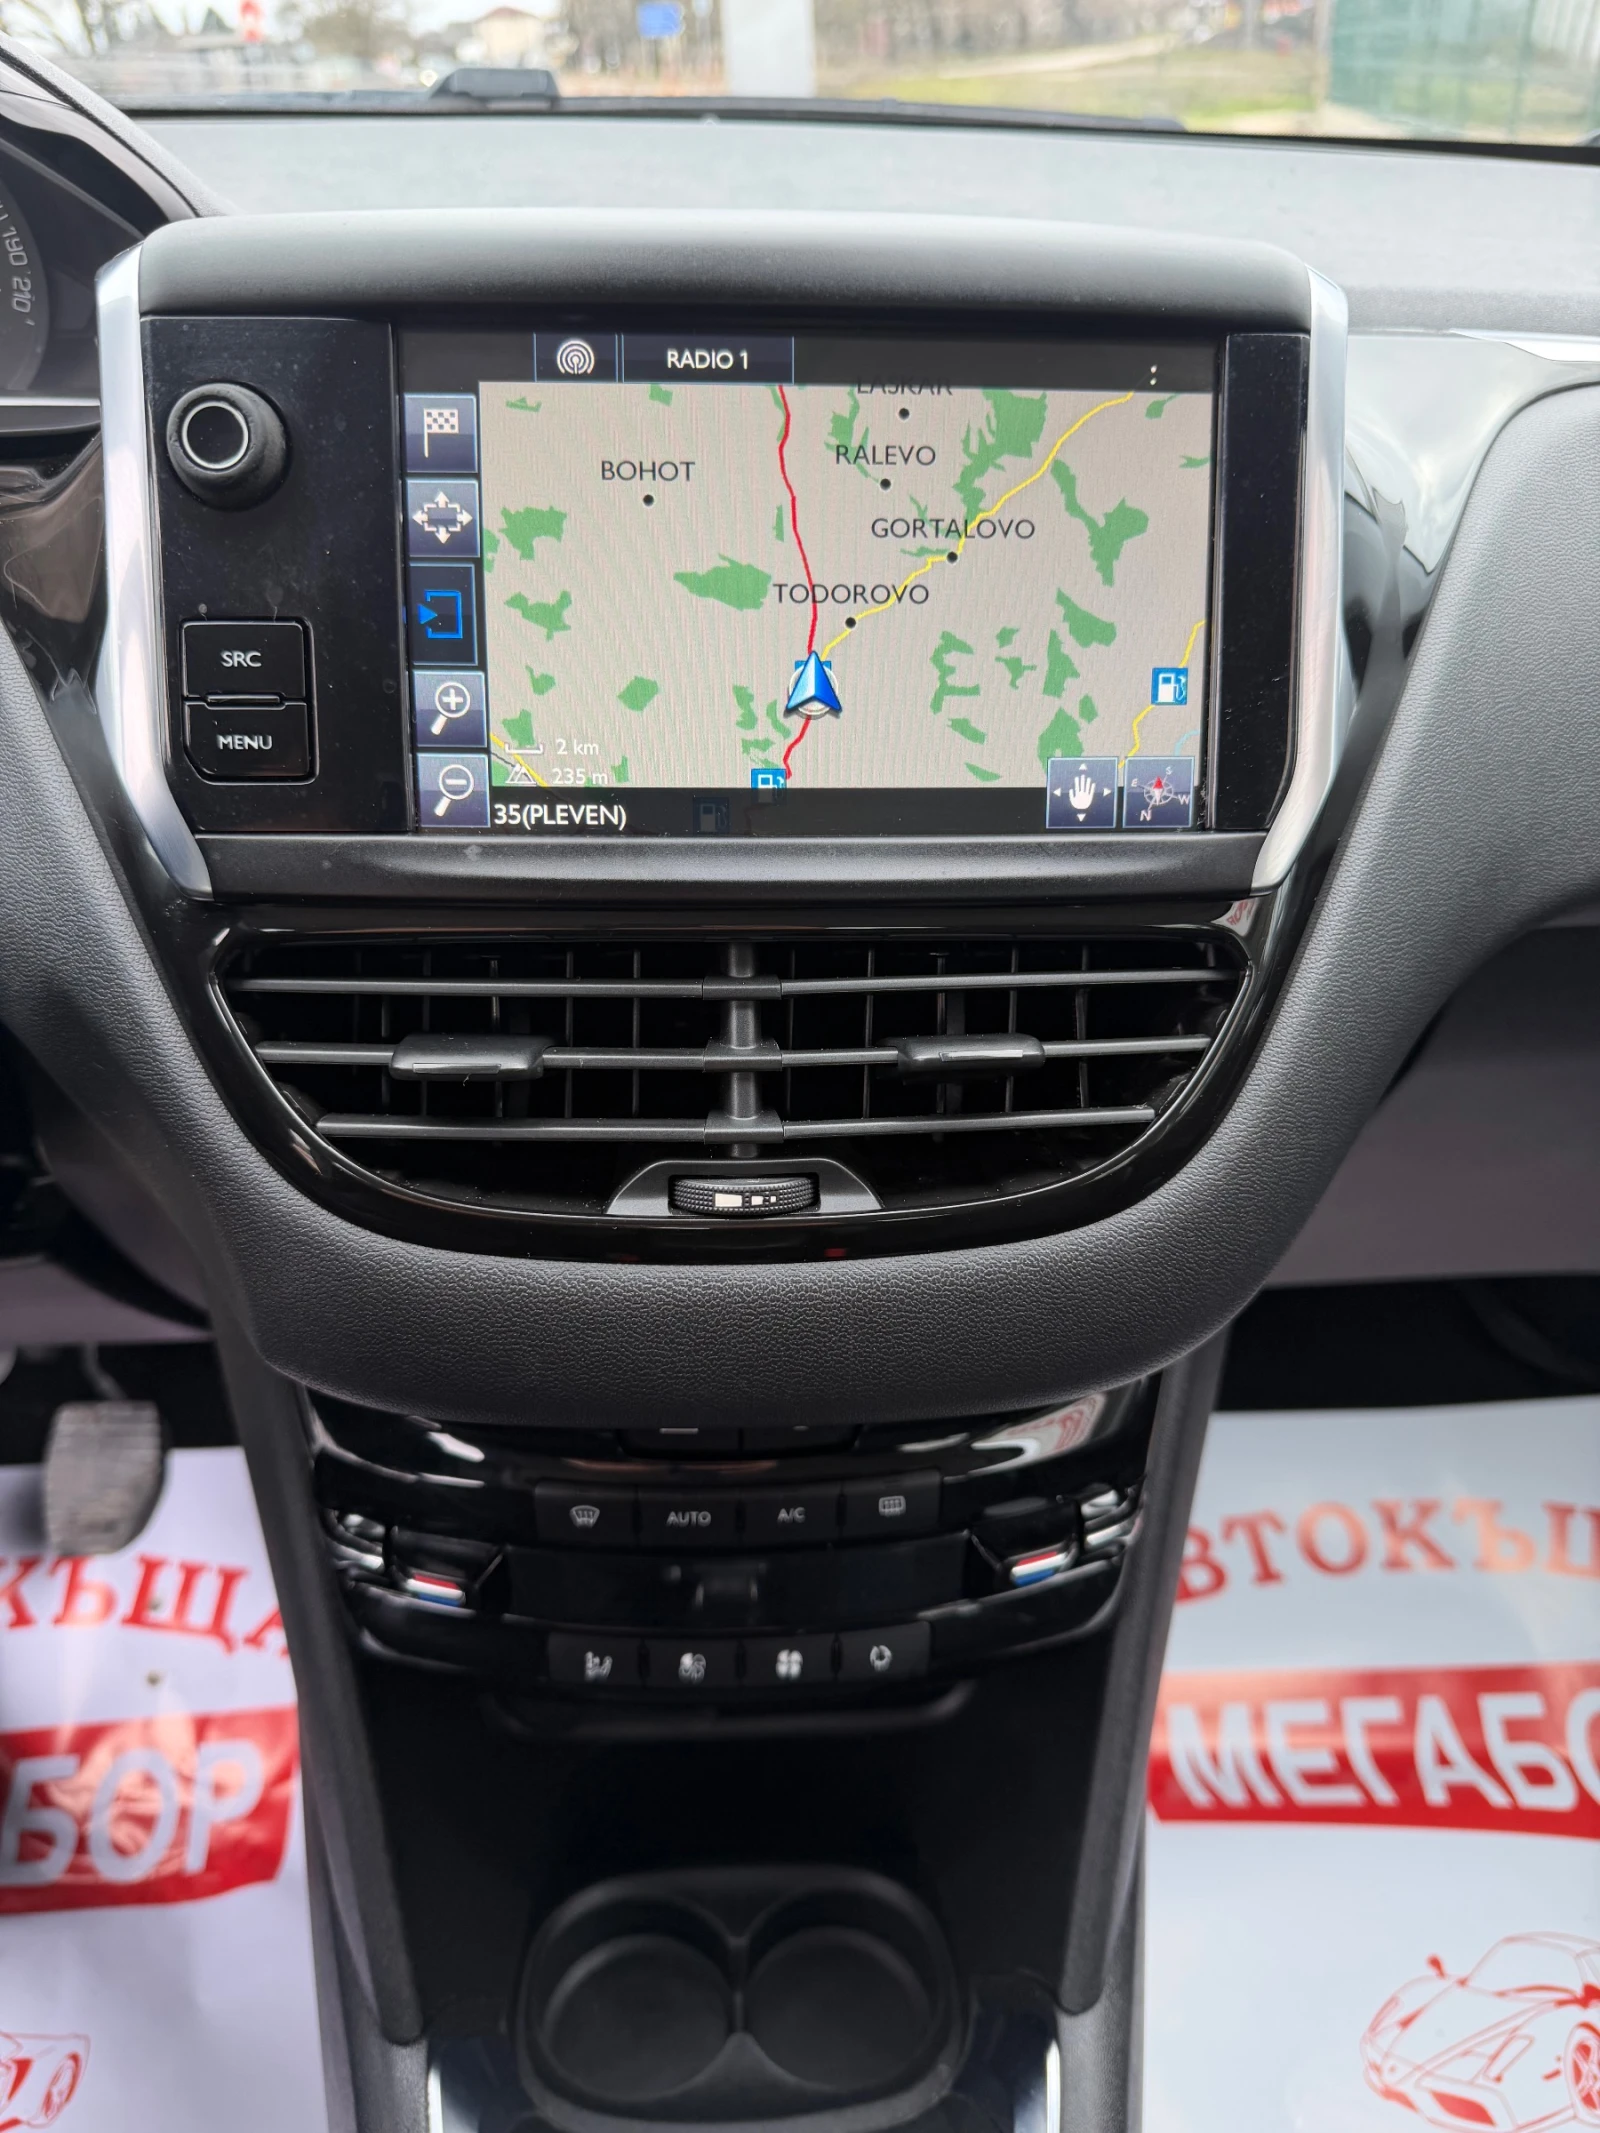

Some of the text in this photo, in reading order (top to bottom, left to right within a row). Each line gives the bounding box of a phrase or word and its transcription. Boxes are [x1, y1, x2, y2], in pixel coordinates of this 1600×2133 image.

[3, 225, 28, 267] 190
[11, 275, 33, 313] 210
[666, 349, 749, 370] RADIO 1
[835, 445, 937, 467] RALEVO
[600, 460, 696, 482] BOHOT
[870, 518, 1036, 540] GORTALOVO
[773, 583, 930, 605] TODOROVO
[220, 651, 263, 668] SRC
[216, 735, 273, 750] MENU
[556, 739, 599, 755] 2 km
[552, 769, 608, 785] 235 m
[493, 803, 627, 831] 35(PLEVEN)
[1139, 810, 1152, 822] N
[666, 1511, 712, 1527] AUTO
[777, 1506, 806, 1524] A/C
